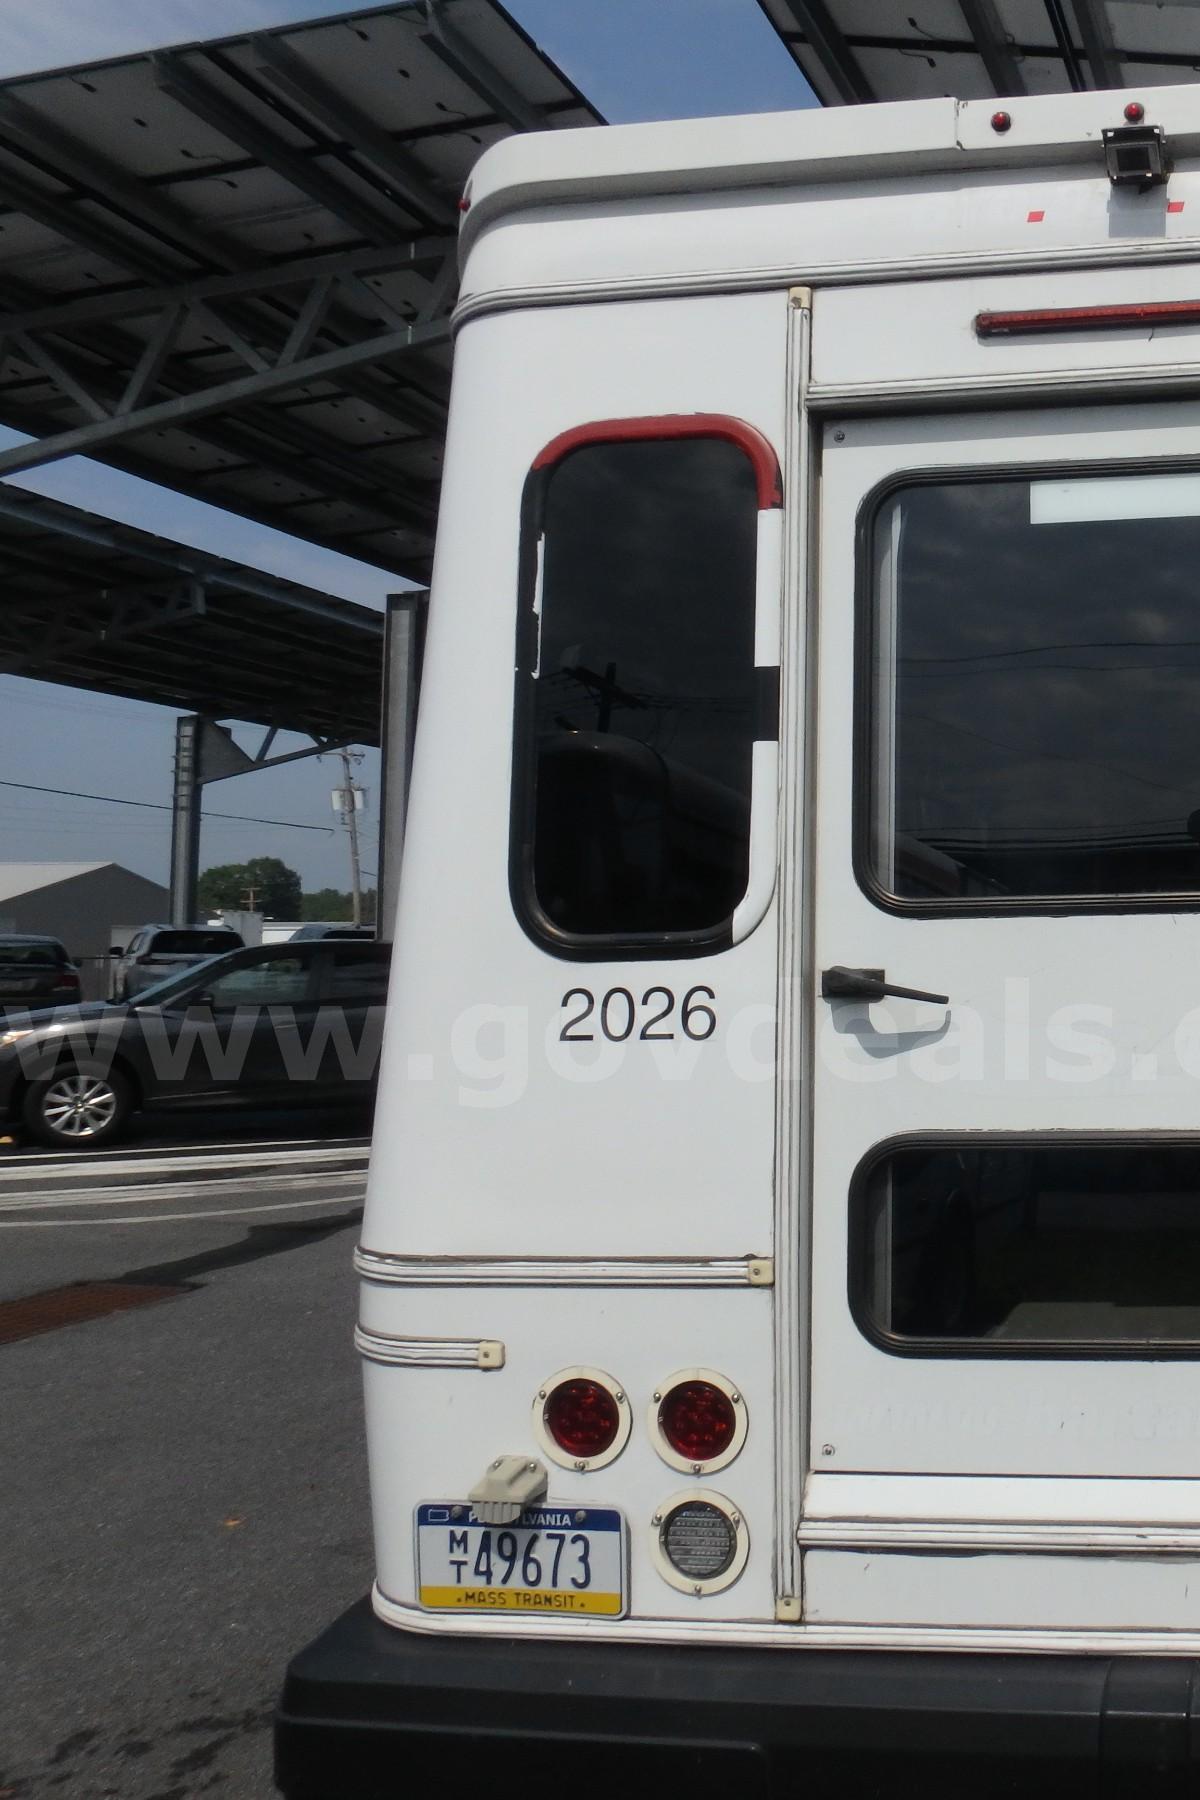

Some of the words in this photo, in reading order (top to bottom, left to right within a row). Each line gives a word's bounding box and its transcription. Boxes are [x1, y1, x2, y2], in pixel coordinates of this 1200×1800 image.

[559, 985, 717, 1042] 2026
[469, 1510, 572, 1527] PLVANIA
[474, 1530, 591, 1590] 49673
[464, 1591, 507, 1606] MASS
[514, 1591, 576, 1608] TRANSIT
